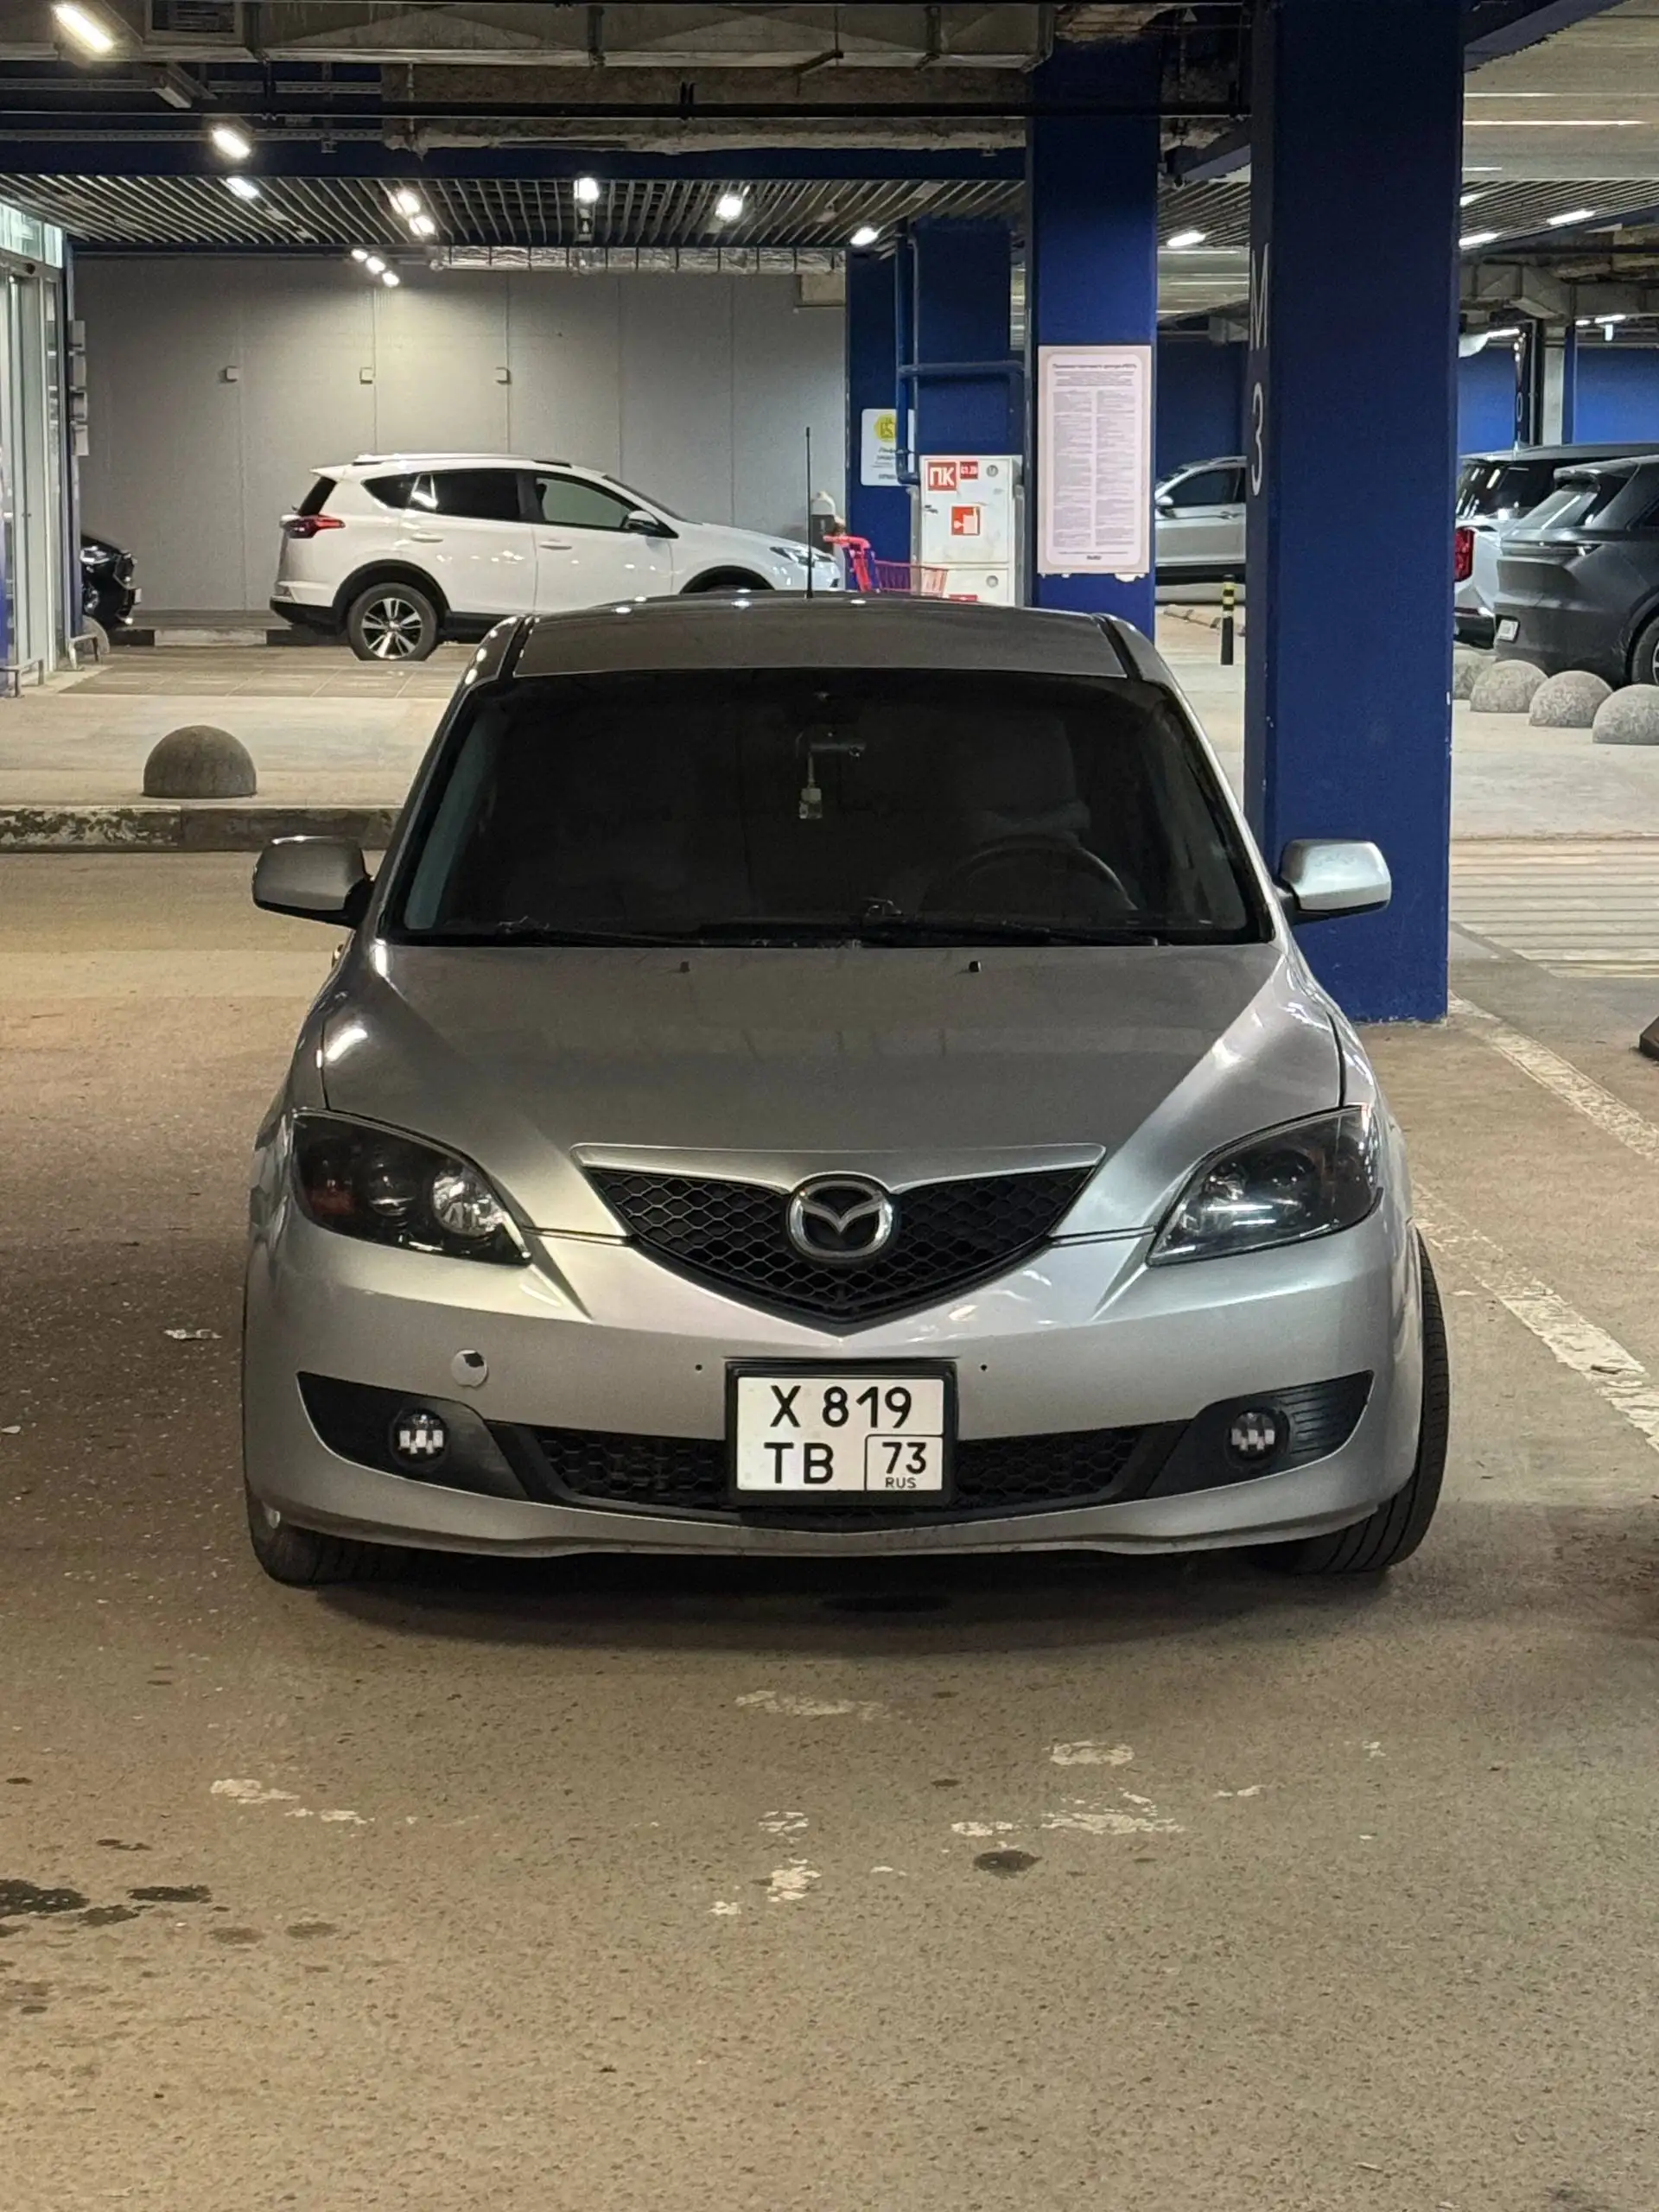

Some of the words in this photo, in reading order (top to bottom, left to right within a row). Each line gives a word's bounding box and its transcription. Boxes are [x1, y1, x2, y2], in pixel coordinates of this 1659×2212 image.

[1251, 382, 1263, 496] 3
[930, 467, 955, 486] ПК
[822, 1386, 912, 1428] 819
[882, 1442, 927, 1474] 73
[885, 1478, 917, 1489] RUS
